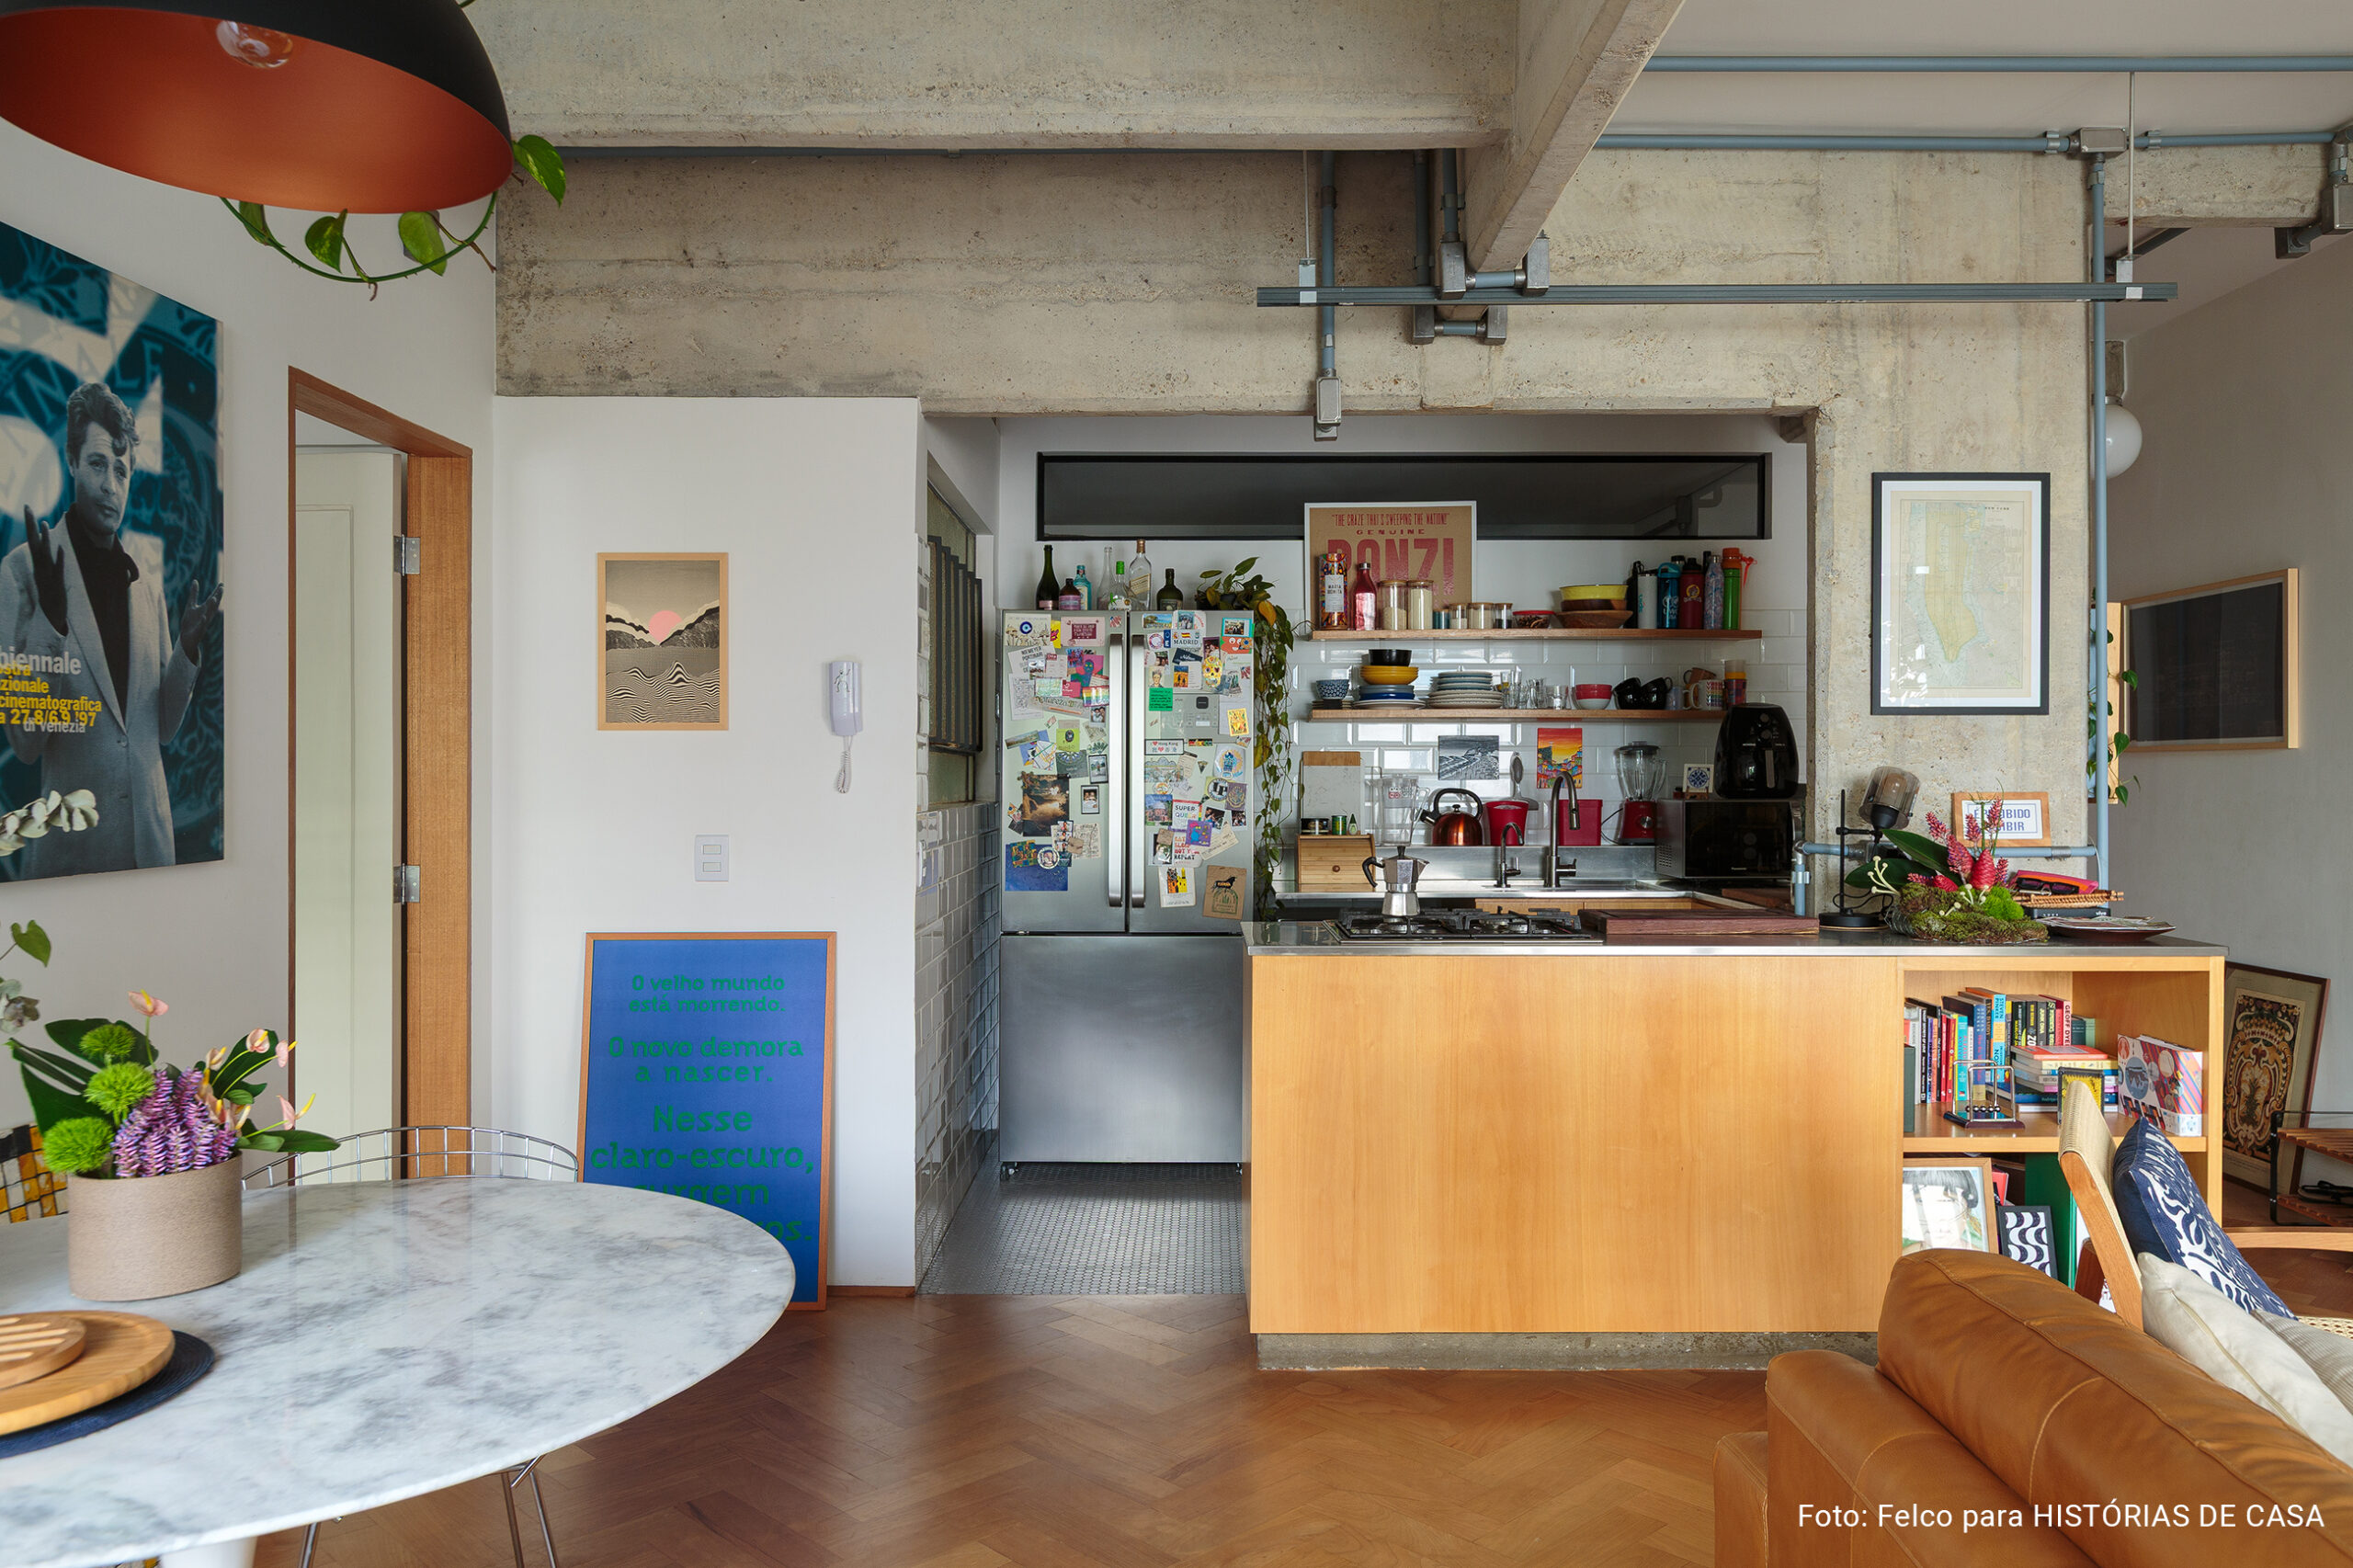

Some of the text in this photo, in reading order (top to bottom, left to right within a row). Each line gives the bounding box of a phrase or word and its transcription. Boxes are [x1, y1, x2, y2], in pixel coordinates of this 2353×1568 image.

[1347, 514, 1364, 526] CRAZE
[1386, 513, 1412, 526] SWEEPING
[1415, 513, 1423, 525] THE
[0, 646, 81, 675] biennale
[0, 691, 102, 713] cinematografica
[40, 720, 86, 733] venezia
[1983, 809, 2030, 818] PIBIDO
[632, 974, 785, 991] O velho mundo
[629, 994, 785, 1012] está morrendo.
[608, 1036, 804, 1057] O novo demora
[2027, 1035, 2036, 1046] ZO
[635, 1065, 773, 1082] a nascer.
[654, 1105, 753, 1132] Nesse
[591, 1142, 814, 1174] claro-escuro,
[633, 1184, 768, 1205] rgem
